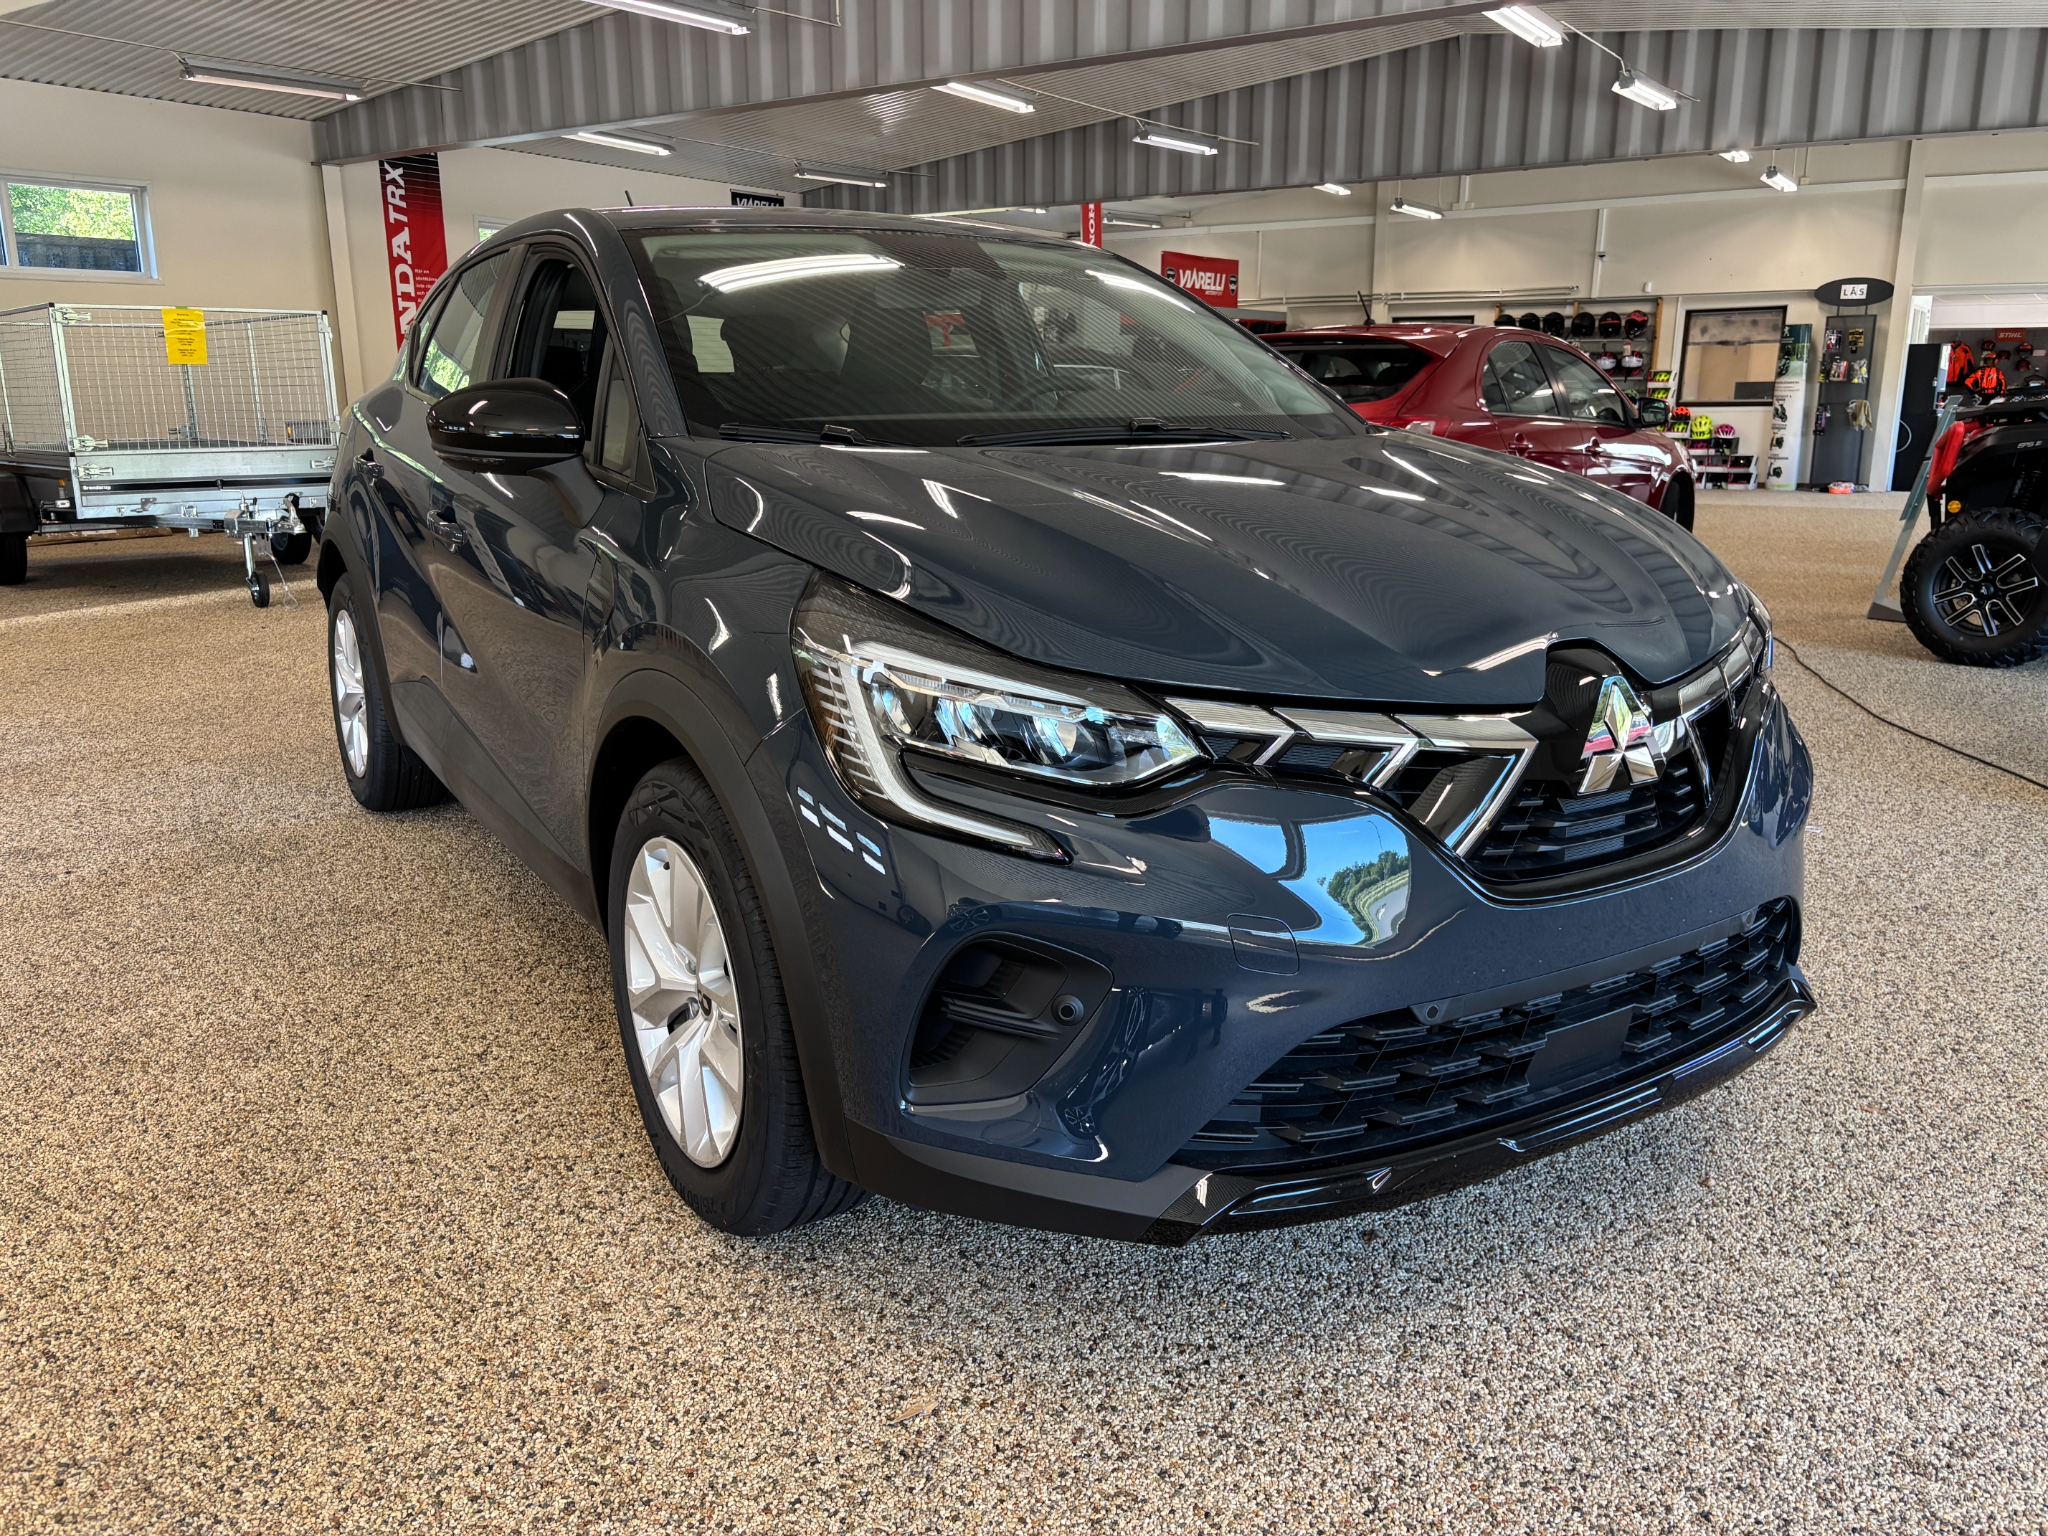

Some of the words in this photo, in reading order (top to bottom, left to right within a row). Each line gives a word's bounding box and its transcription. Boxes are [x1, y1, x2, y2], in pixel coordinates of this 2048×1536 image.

[385, 161, 409, 224] TRX
[1179, 267, 1225, 291] VIARELLI
[1843, 286, 1865, 297] LÅS
